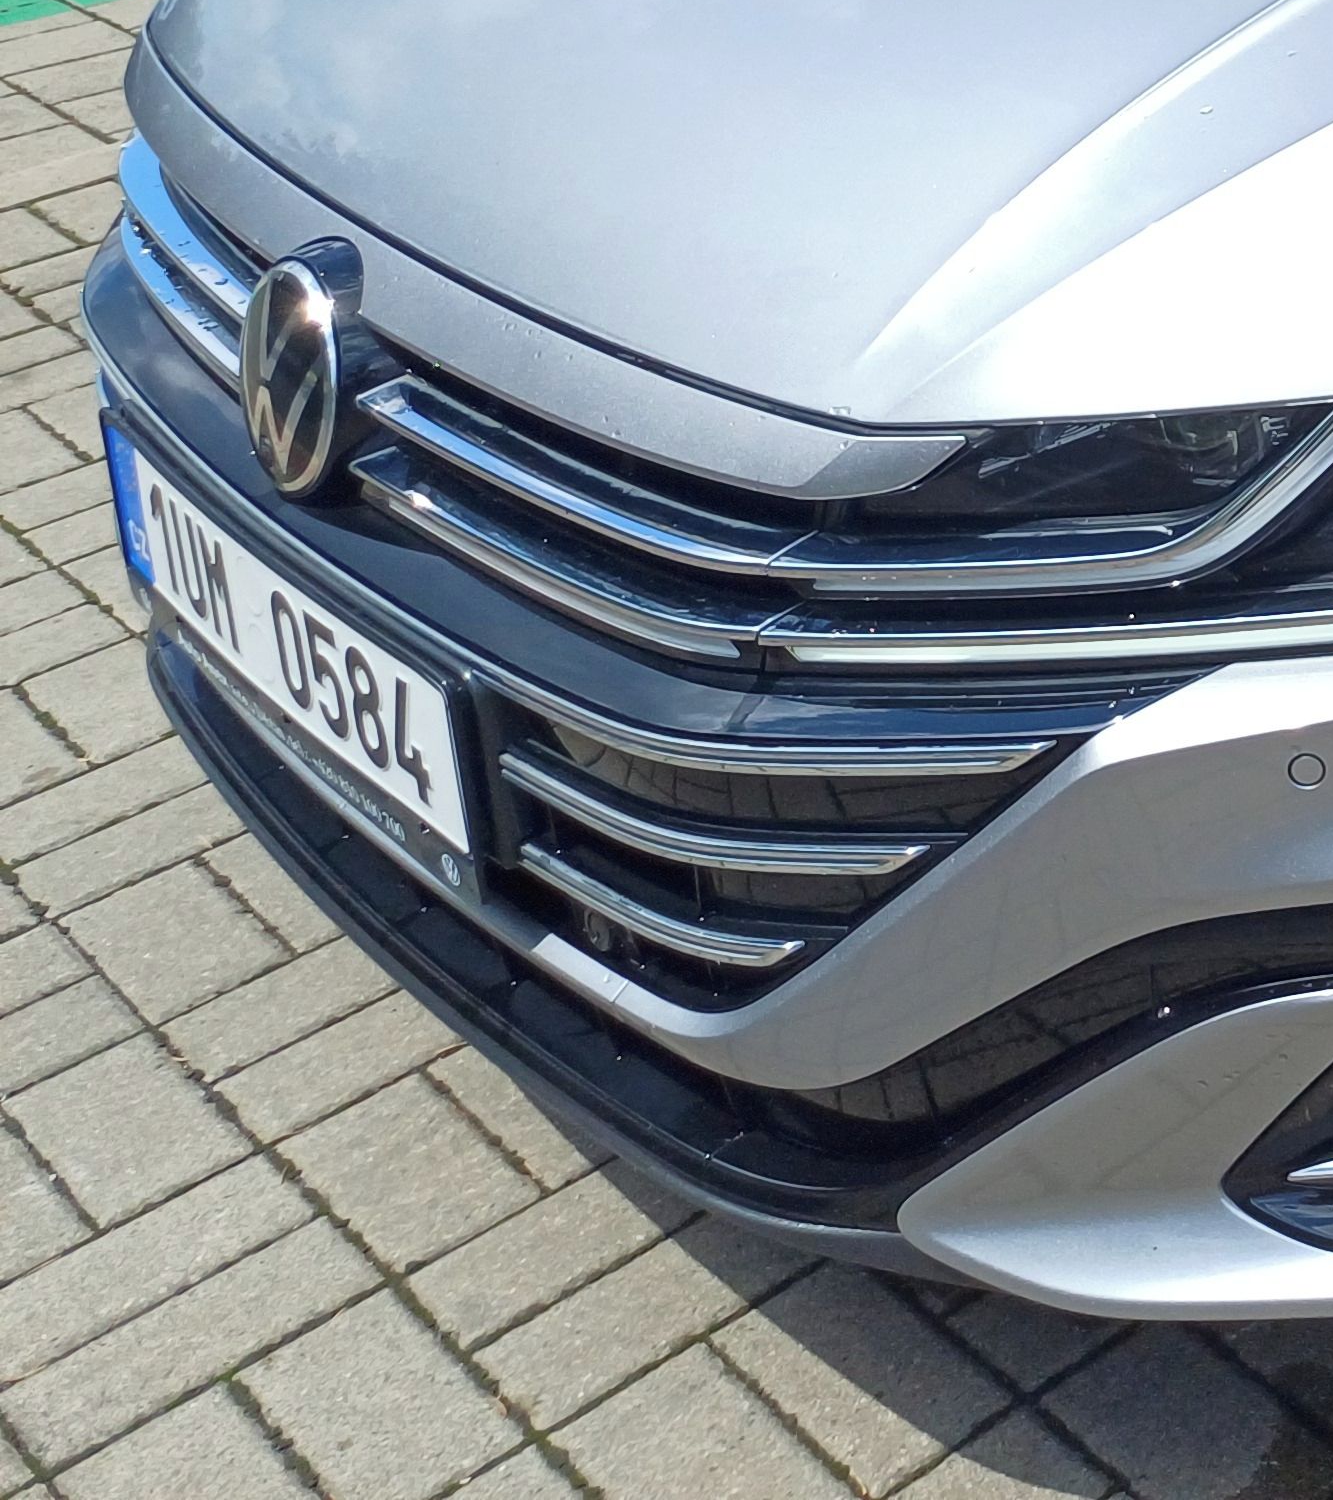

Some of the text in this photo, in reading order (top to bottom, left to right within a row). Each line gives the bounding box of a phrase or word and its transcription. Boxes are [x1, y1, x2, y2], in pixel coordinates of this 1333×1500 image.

[127, 518, 151, 562] CZ
[150, 483, 241, 655] 1UM
[270, 590, 432, 808] 0584
